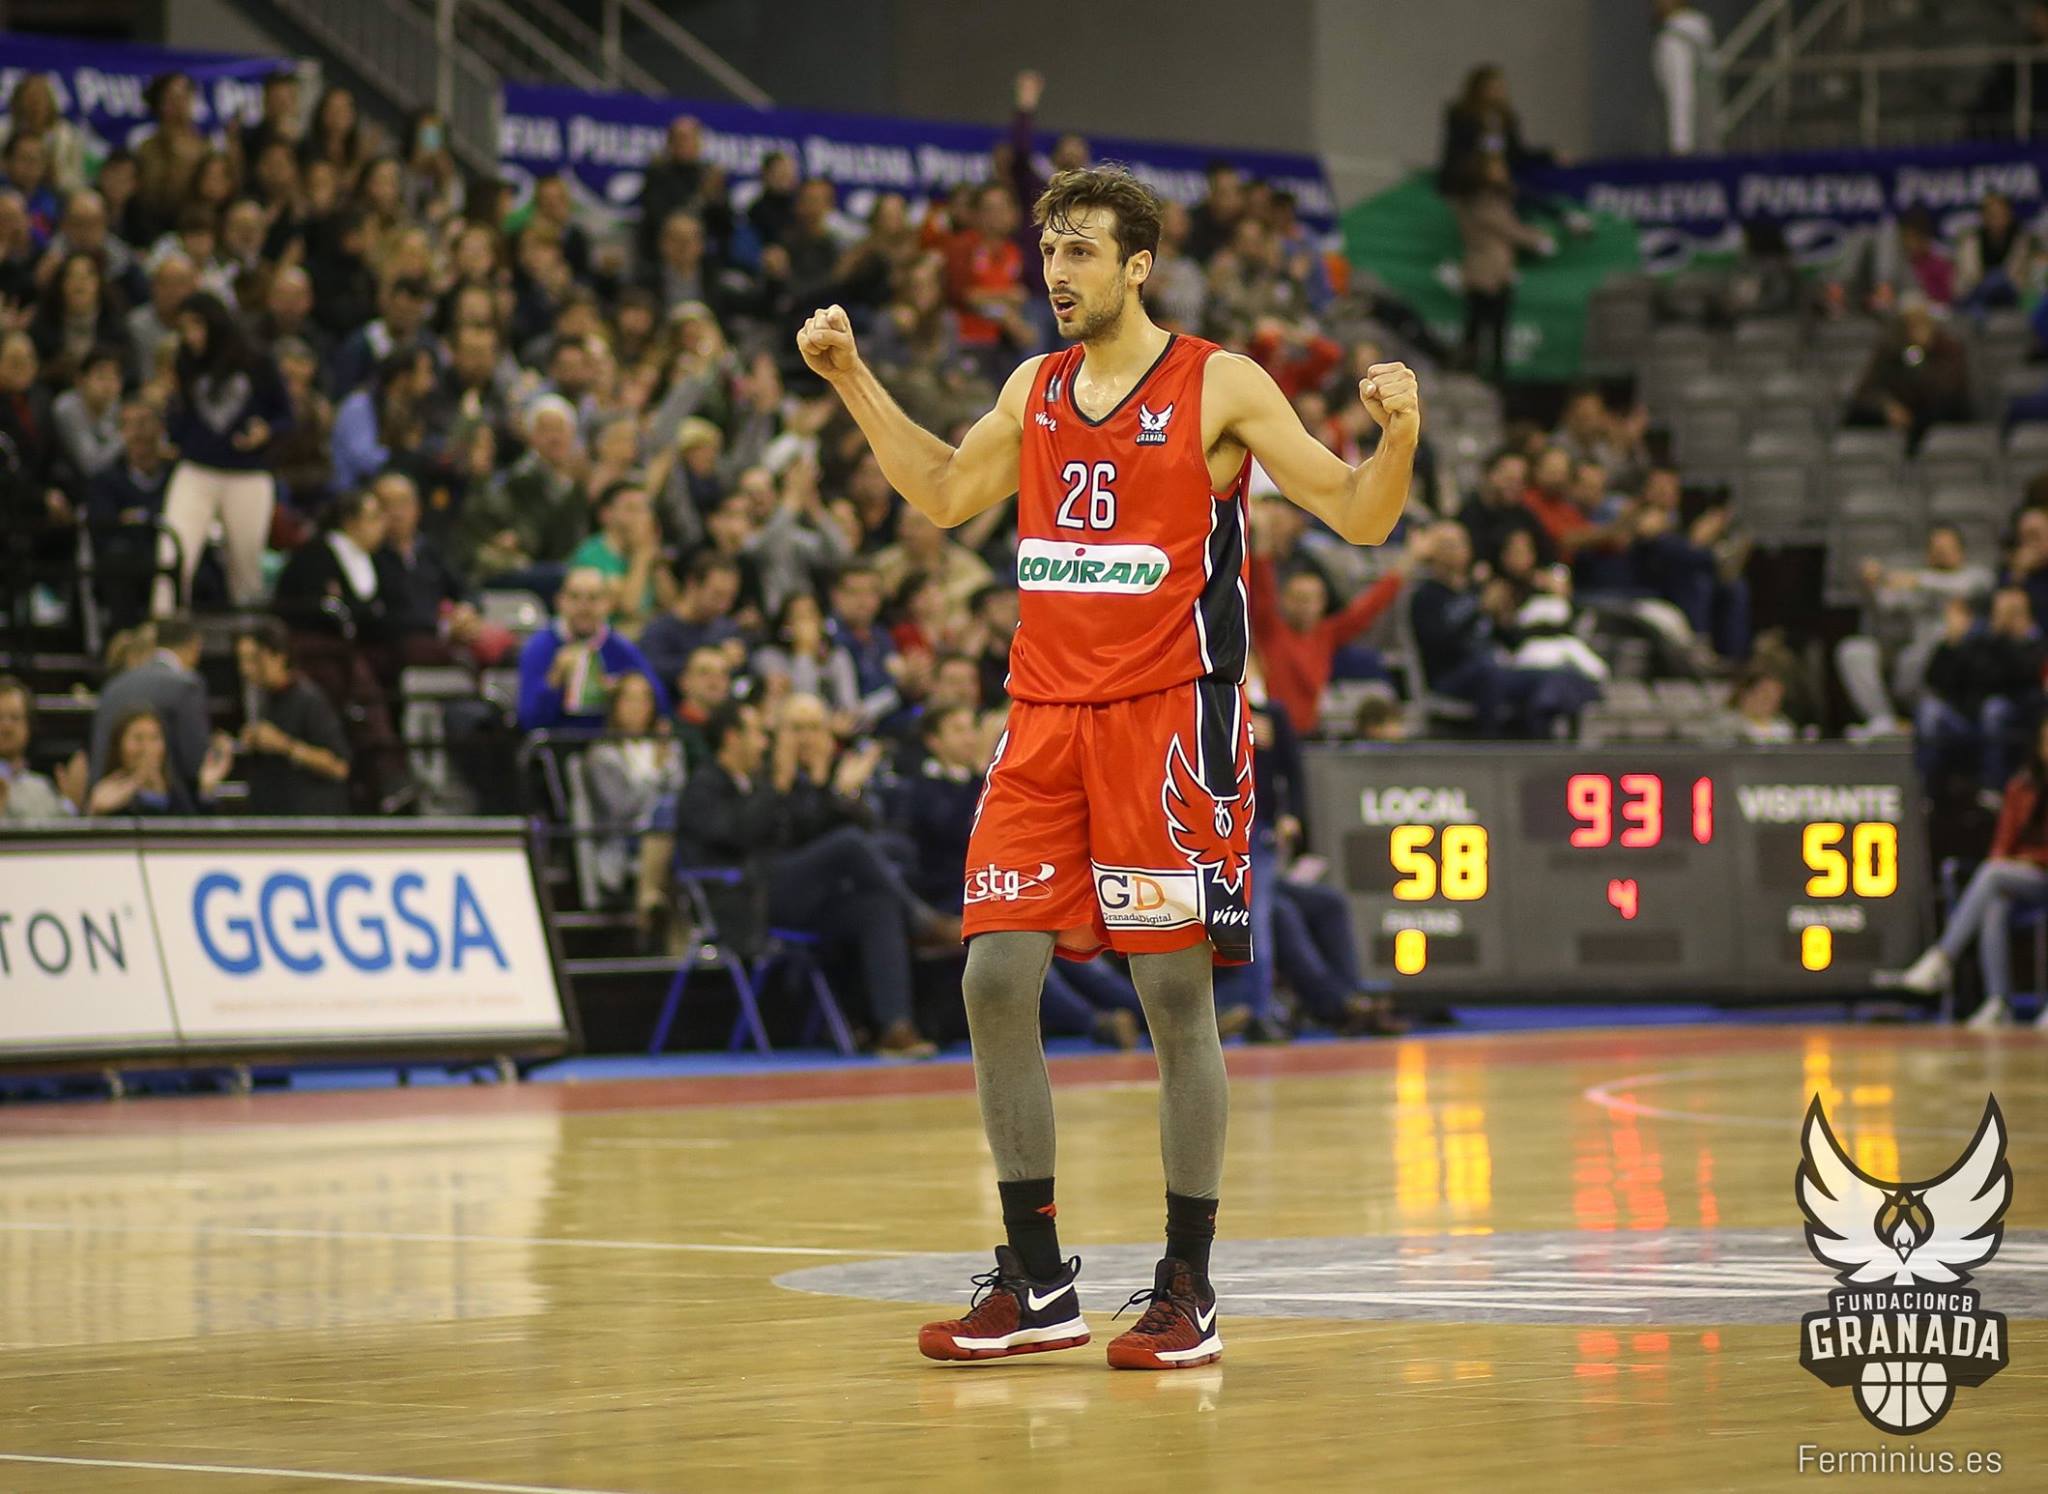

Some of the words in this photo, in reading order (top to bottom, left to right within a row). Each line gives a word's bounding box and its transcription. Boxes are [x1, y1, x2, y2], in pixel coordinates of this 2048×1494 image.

[1056, 460, 1116, 531] 26
[1019, 553, 1164, 585] COVIRAN
[1362, 786, 1477, 824] LOCAL
[1737, 785, 1903, 822] VISITANTE
[1390, 825, 1489, 900] 58
[1802, 822, 1898, 898] 50
[976, 863, 1019, 901] stg
[1098, 874, 1165, 911] GD
[1607, 878, 1638, 919] 4
